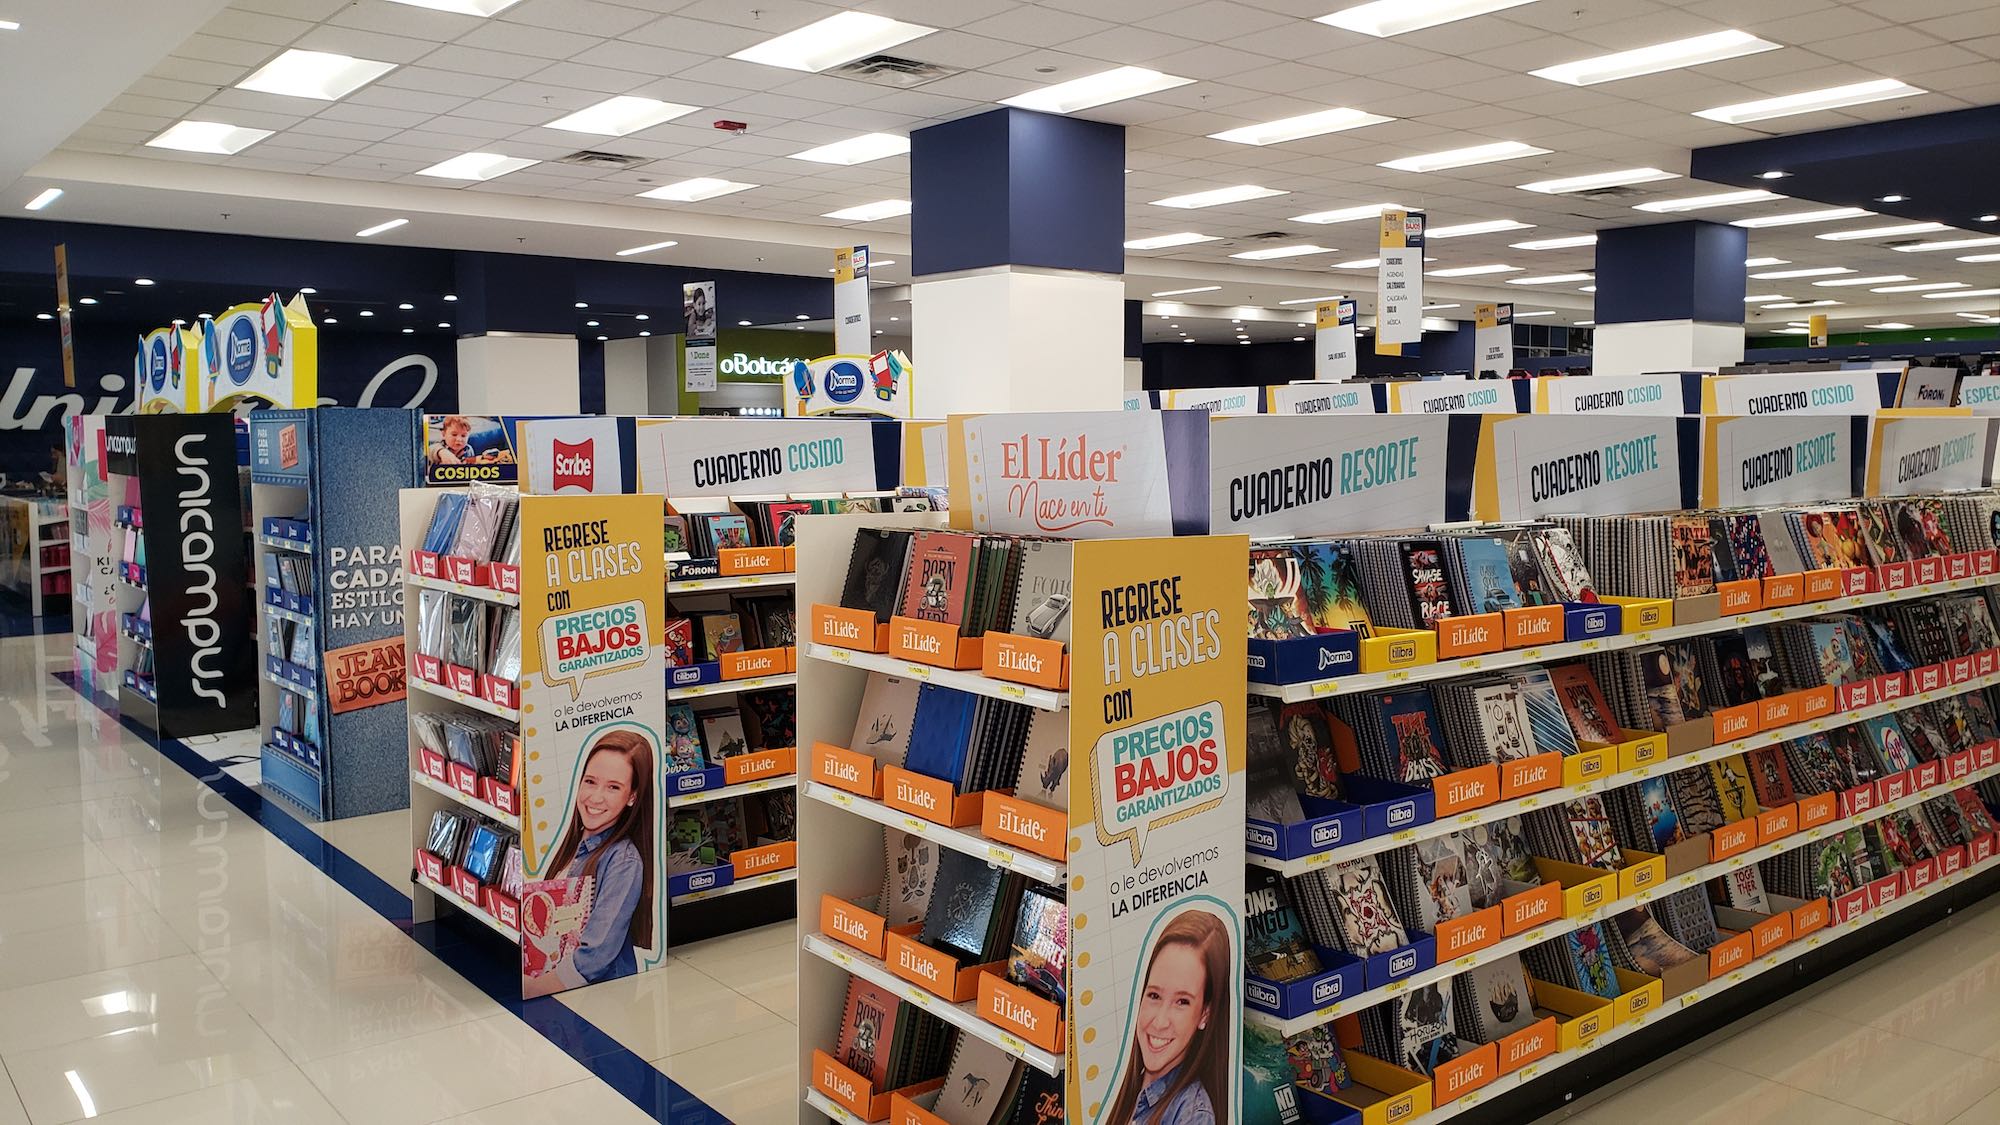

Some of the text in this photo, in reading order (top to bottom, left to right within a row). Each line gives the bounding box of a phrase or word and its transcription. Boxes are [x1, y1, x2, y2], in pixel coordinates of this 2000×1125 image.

[230, 331, 252, 366] Norma
[829, 369, 857, 392] Norma
[1223, 395, 1246, 411] COSIDO
[1295, 391, 1359, 414] CUADERNO COSIDO
[1423, 388, 1498, 414] CUADERNO COSIDO
[1575, 384, 1662, 412] CUADERNO COSIDO
[1748, 384, 1854, 415] CUADERNO COSIDO
[556, 452, 592, 477] Scribe
[693, 437, 844, 489] CUADERNO COSIDO
[1001, 433, 1122, 483] El Líder
[1531, 433, 1659, 503] CUADERNO RESORTE
[1742, 432, 1837, 492] CUADERNO RESORTE
[1899, 432, 1976, 485] CUADERNO RESORTE
[434, 465, 500, 480] COSIDOS
[1229, 436, 1419, 523] CUADERNO RESORTE
[1072, 498, 1094, 518] en
[1093, 484, 1108, 516] ti
[543, 519, 609, 552] REGRESE
[331, 545, 404, 567] PARA
[546, 541, 643, 588] A CLASES
[734, 556, 770, 568] El Líder
[174, 433, 226, 709] unicampus
[330, 569, 404, 589] CADA
[504, 575, 516, 584] Scribe
[547, 589, 571, 612] CON
[1100, 575, 1183, 630] REGRESE
[331, 612, 374, 629] HAY
[555, 605, 637, 637] PRECIOS
[824, 619, 860, 640] El Líder
[1517, 617, 1551, 636] El Líder
[557, 623, 641, 661] BAJOS
[903, 633, 942, 654] El Líder
[1103, 609, 1222, 686] A CLASES
[1452, 626, 1489, 647] El Líder
[336, 643, 406, 679] JEAN
[558, 645, 644, 674] GARANTIZADOS
[998, 651, 1043, 673] El Líder
[1318, 647, 1353, 671] Norma
[1391, 645, 1413, 659] tilibra
[736, 658, 772, 673] El Líder
[337, 673, 407, 704] BOOK
[563, 704, 574, 716] le
[576, 690, 643, 713] devolvemos
[1103, 688, 1133, 724] CON
[555, 705, 634, 733] LA DIFERENCIA
[1113, 710, 1214, 766] PRECIOS
[740, 757, 776, 775] El Líder
[824, 759, 860, 782] El Líder
[1115, 738, 1218, 803] BAJOS
[1513, 766, 1547, 787] El Líder
[897, 785, 936, 810] El Líder
[1116, 773, 1222, 824] GARANTIZADOS
[1449, 781, 1485, 805] El Líder
[998, 812, 1047, 842] El Líder
[1389, 807, 1412, 822] tilibra
[1314, 825, 1339, 842] tilibra
[745, 851, 780, 870] El Líder
[1122, 871, 1135, 891] le
[1138, 846, 1220, 882] devolvemos
[1112, 870, 1209, 919] LA DIFERENCIA
[1515, 898, 1549, 923] El Líder
[833, 914, 869, 941] El Líder
[1451, 925, 1487, 950] El Líder
[899, 951, 939, 982] El Líder
[1392, 956, 1414, 971] tilibra
[1248, 985, 1276, 1004] tilibra
[1316, 981, 1340, 998] tilibra
[993, 996, 1038, 1031] El Líder
[1511, 1036, 1544, 1062] El Líder
[824, 1071, 857, 1103] El Líder
[1449, 1065, 1484, 1092] El Líder
[1388, 1100, 1411, 1118] tilibra
